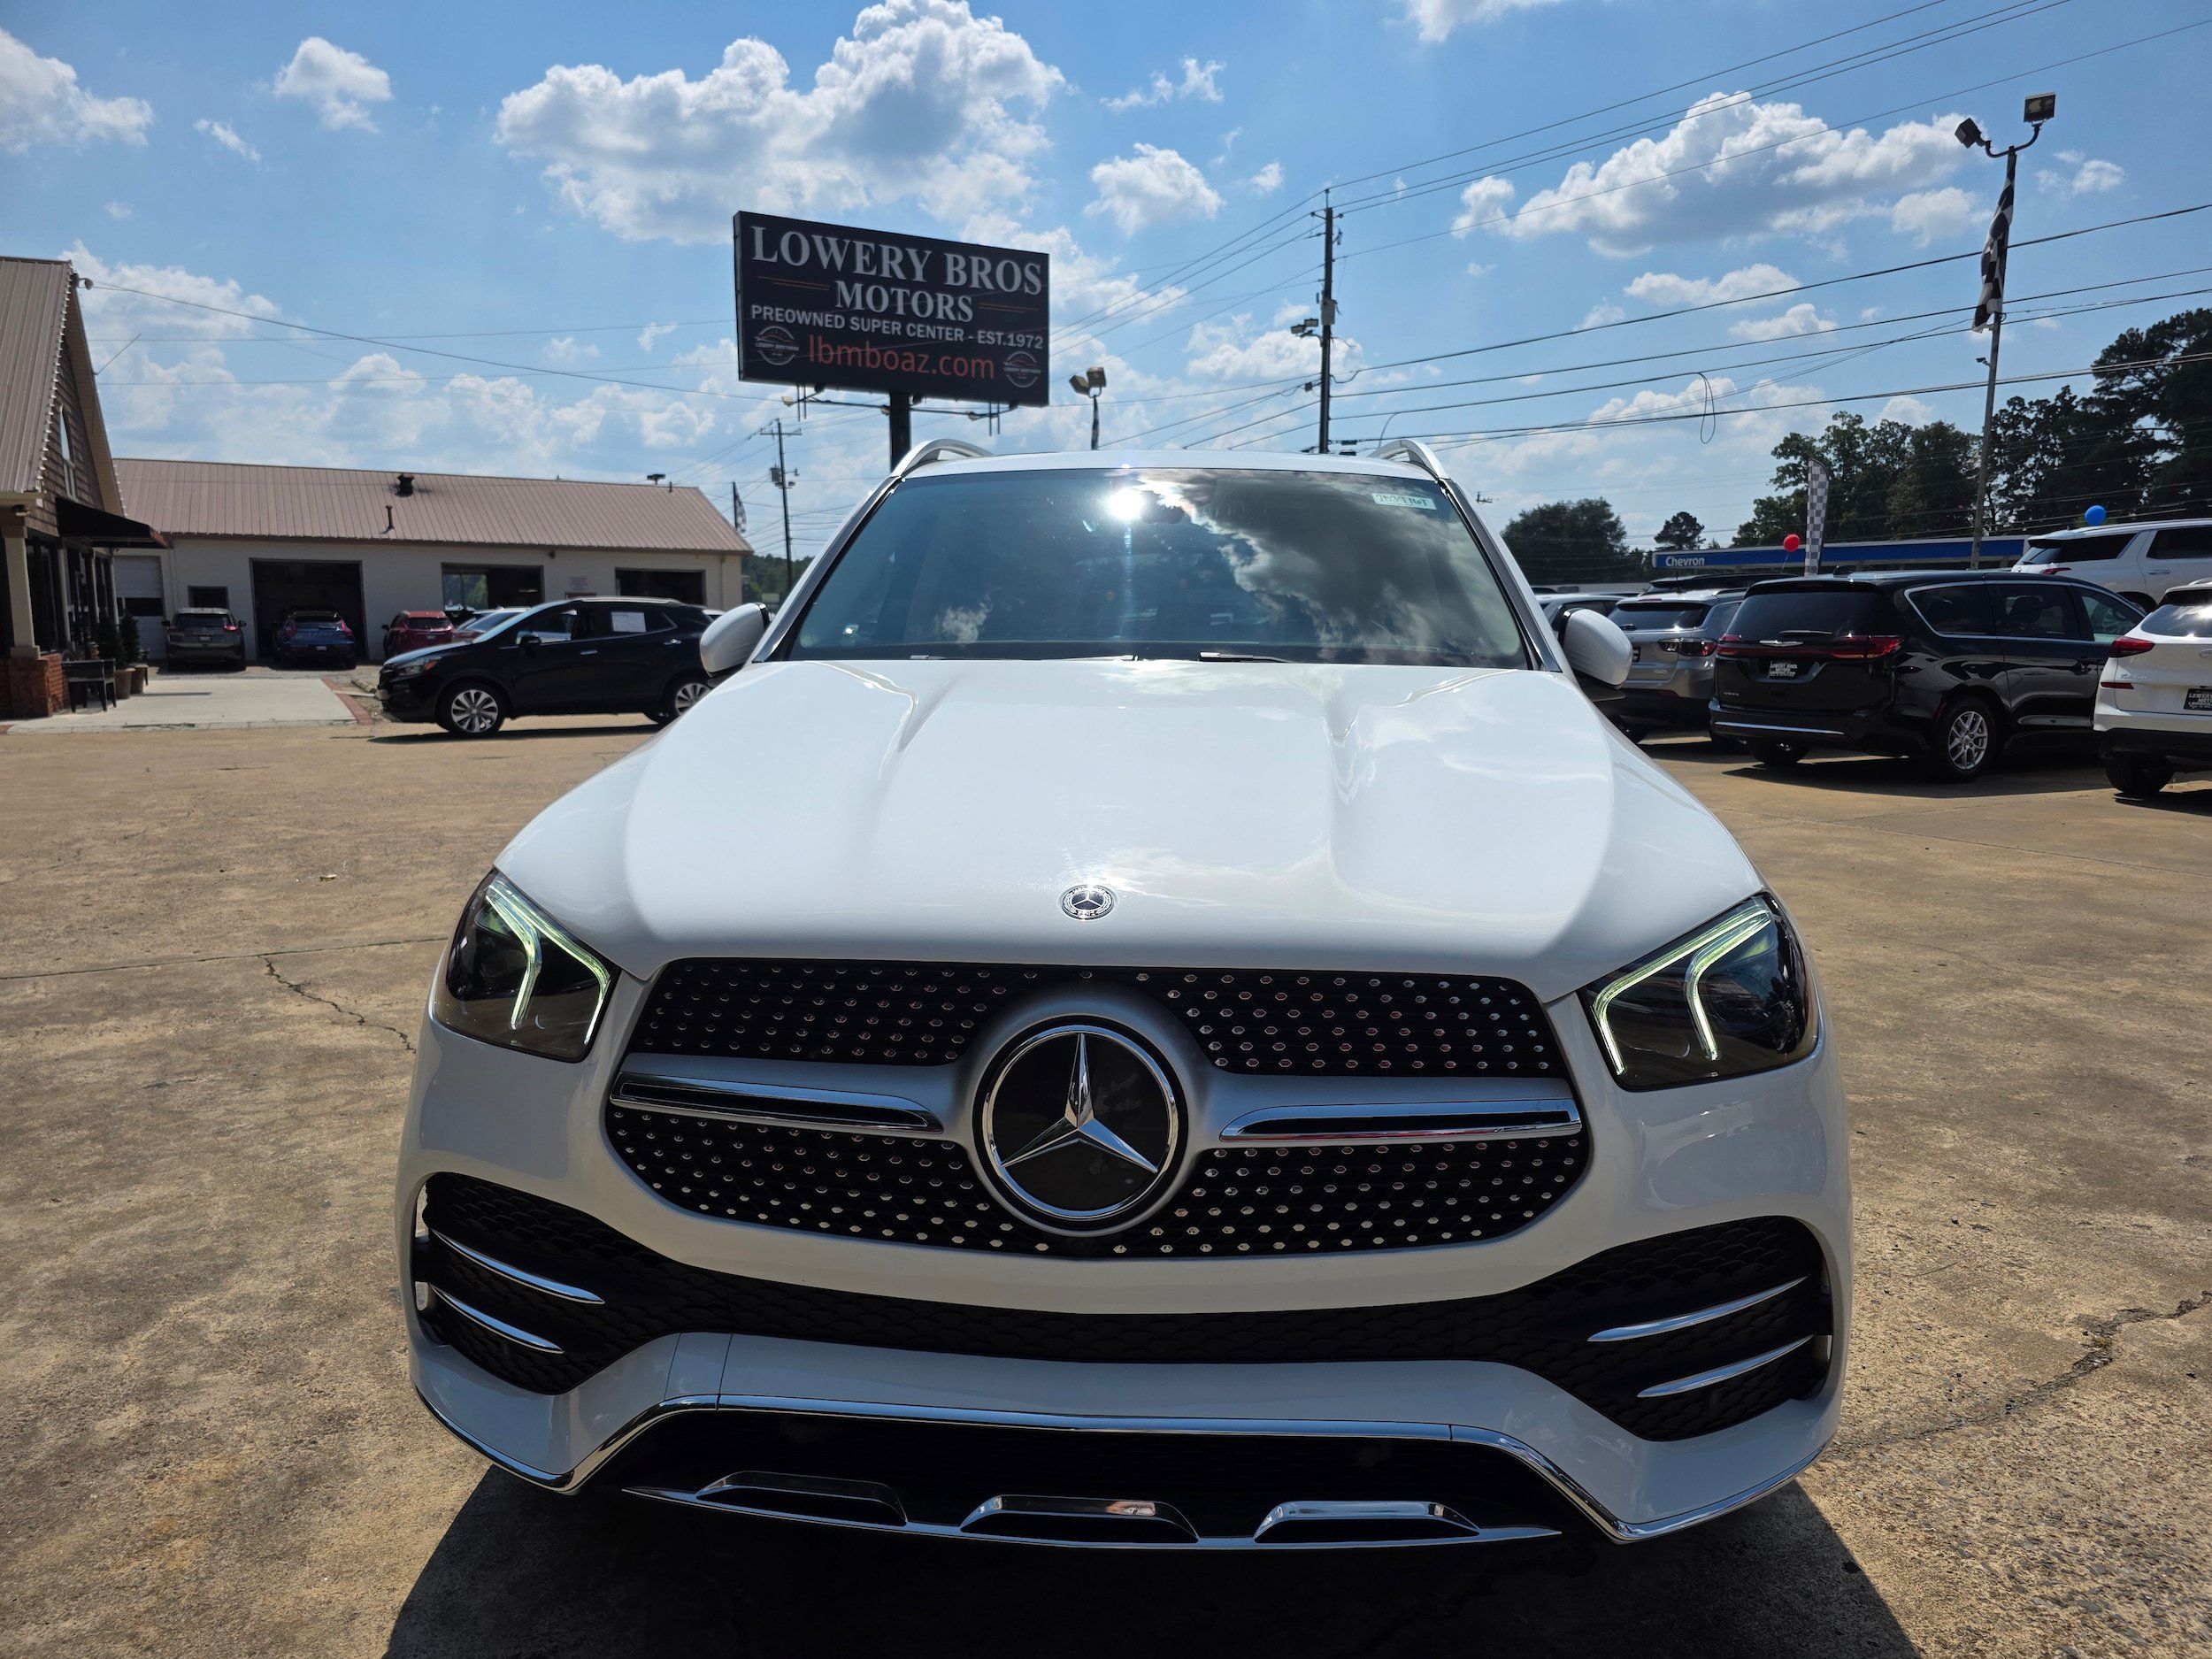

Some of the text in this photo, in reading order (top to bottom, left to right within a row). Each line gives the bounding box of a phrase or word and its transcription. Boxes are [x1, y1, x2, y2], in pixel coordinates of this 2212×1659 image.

[751, 226, 1042, 296] LOWERY BROS
[834, 280, 973, 323] MOTORS
[751, 304, 845, 329] PREOWNED
[849, 316, 902, 336] SUPER
[906, 323, 964, 342] CENTER
[977, 330, 1043, 349] EST.1972
[808, 334, 995, 379] lbmboaz.com
[1665, 556, 1705, 567] Chevron
